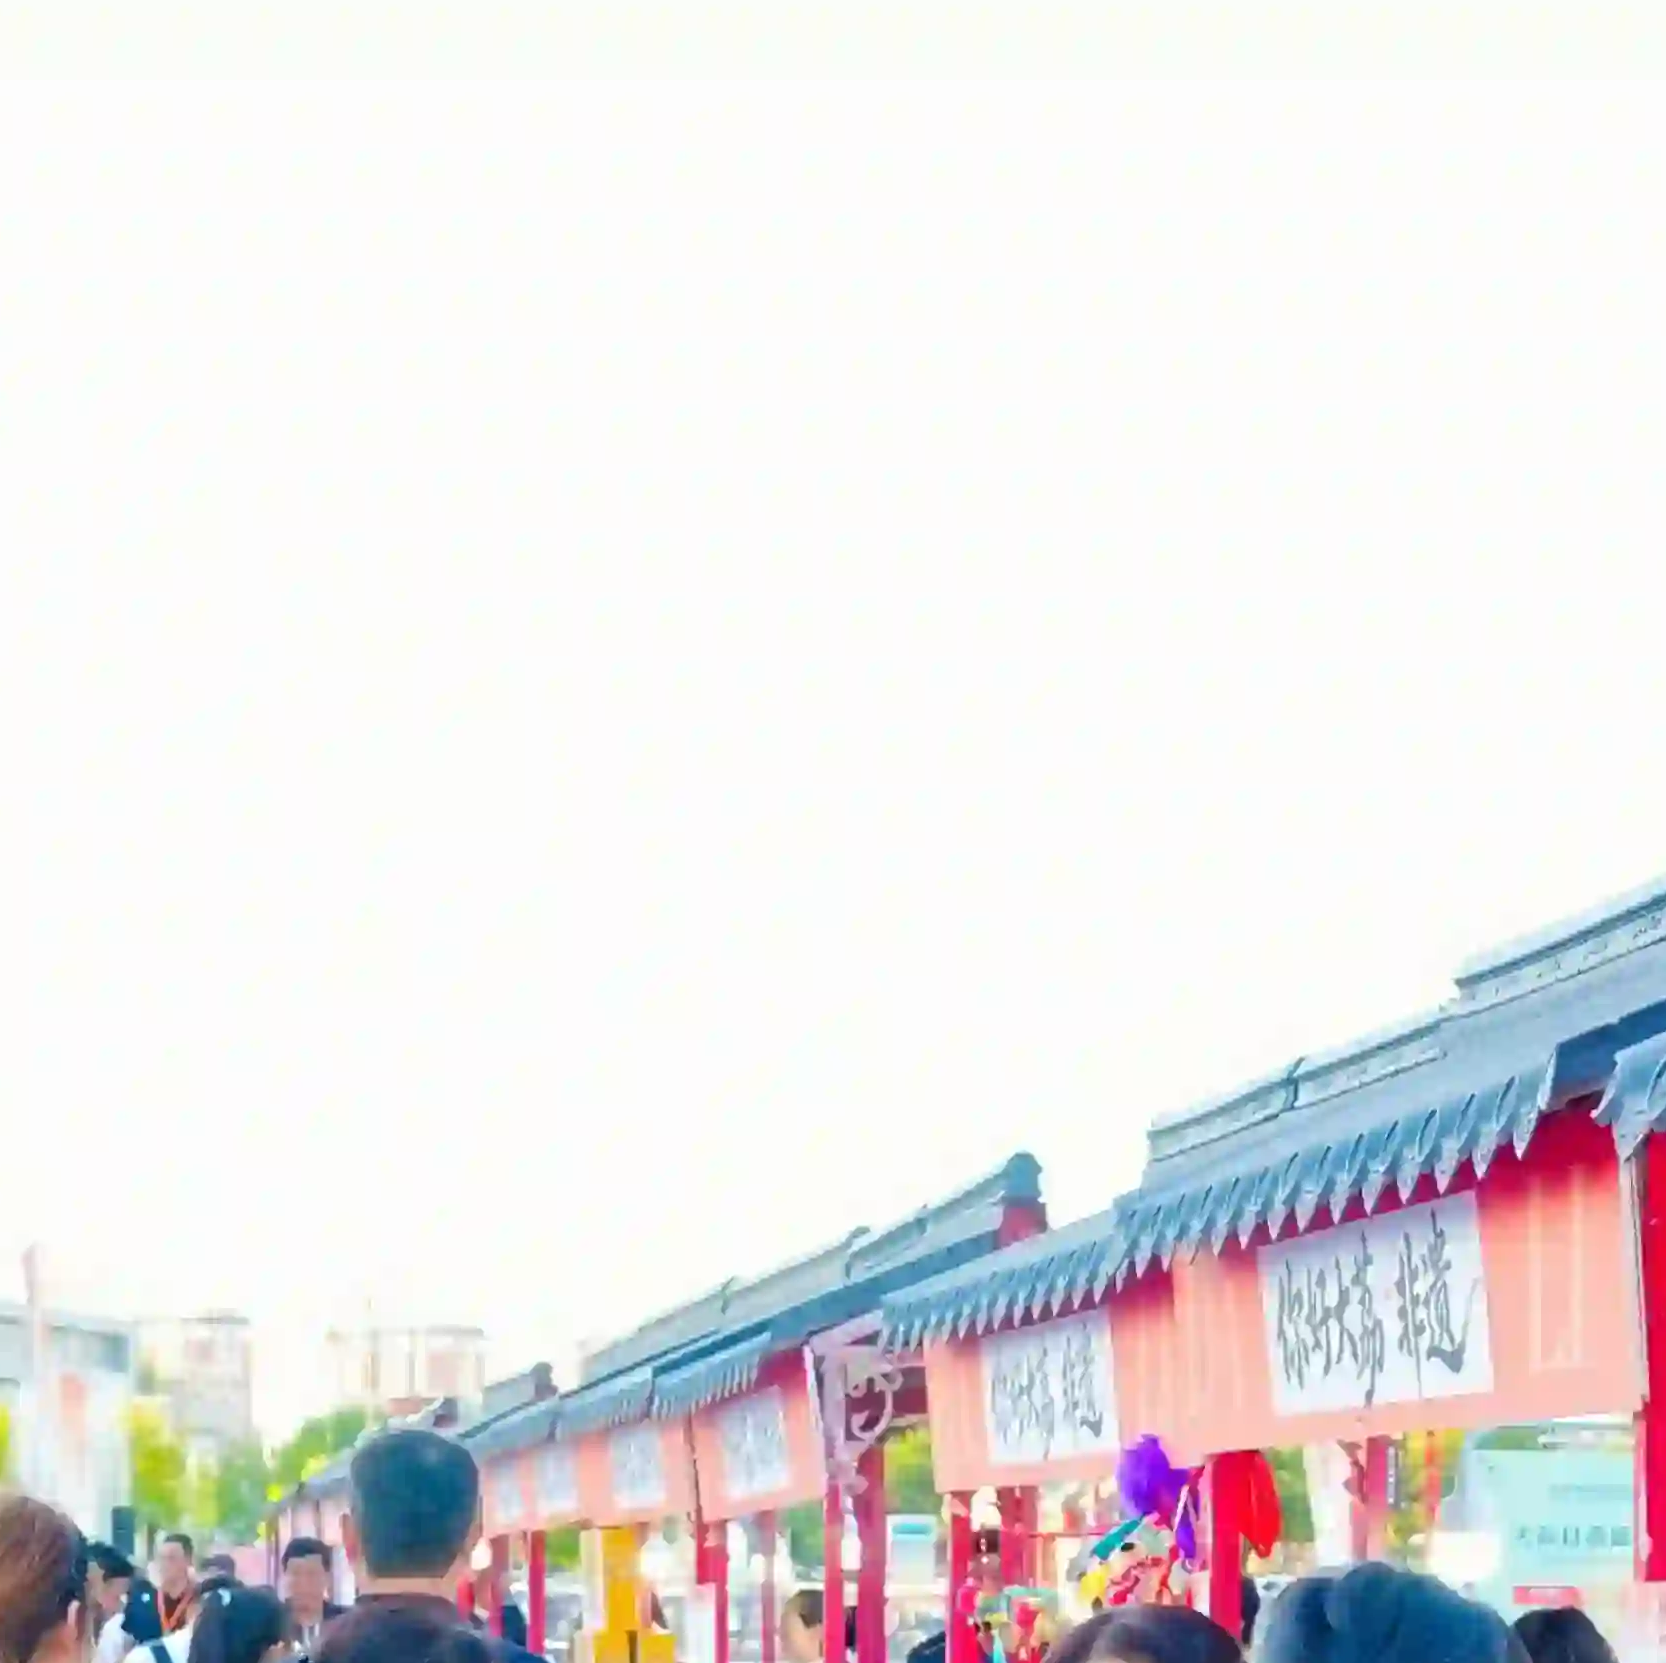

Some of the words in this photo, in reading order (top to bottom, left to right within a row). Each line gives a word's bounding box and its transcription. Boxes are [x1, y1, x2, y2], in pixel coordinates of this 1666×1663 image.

[1276, 1228, 1385, 1410] 你好大荔
[1394, 1206, 1481, 1399] 非遗
